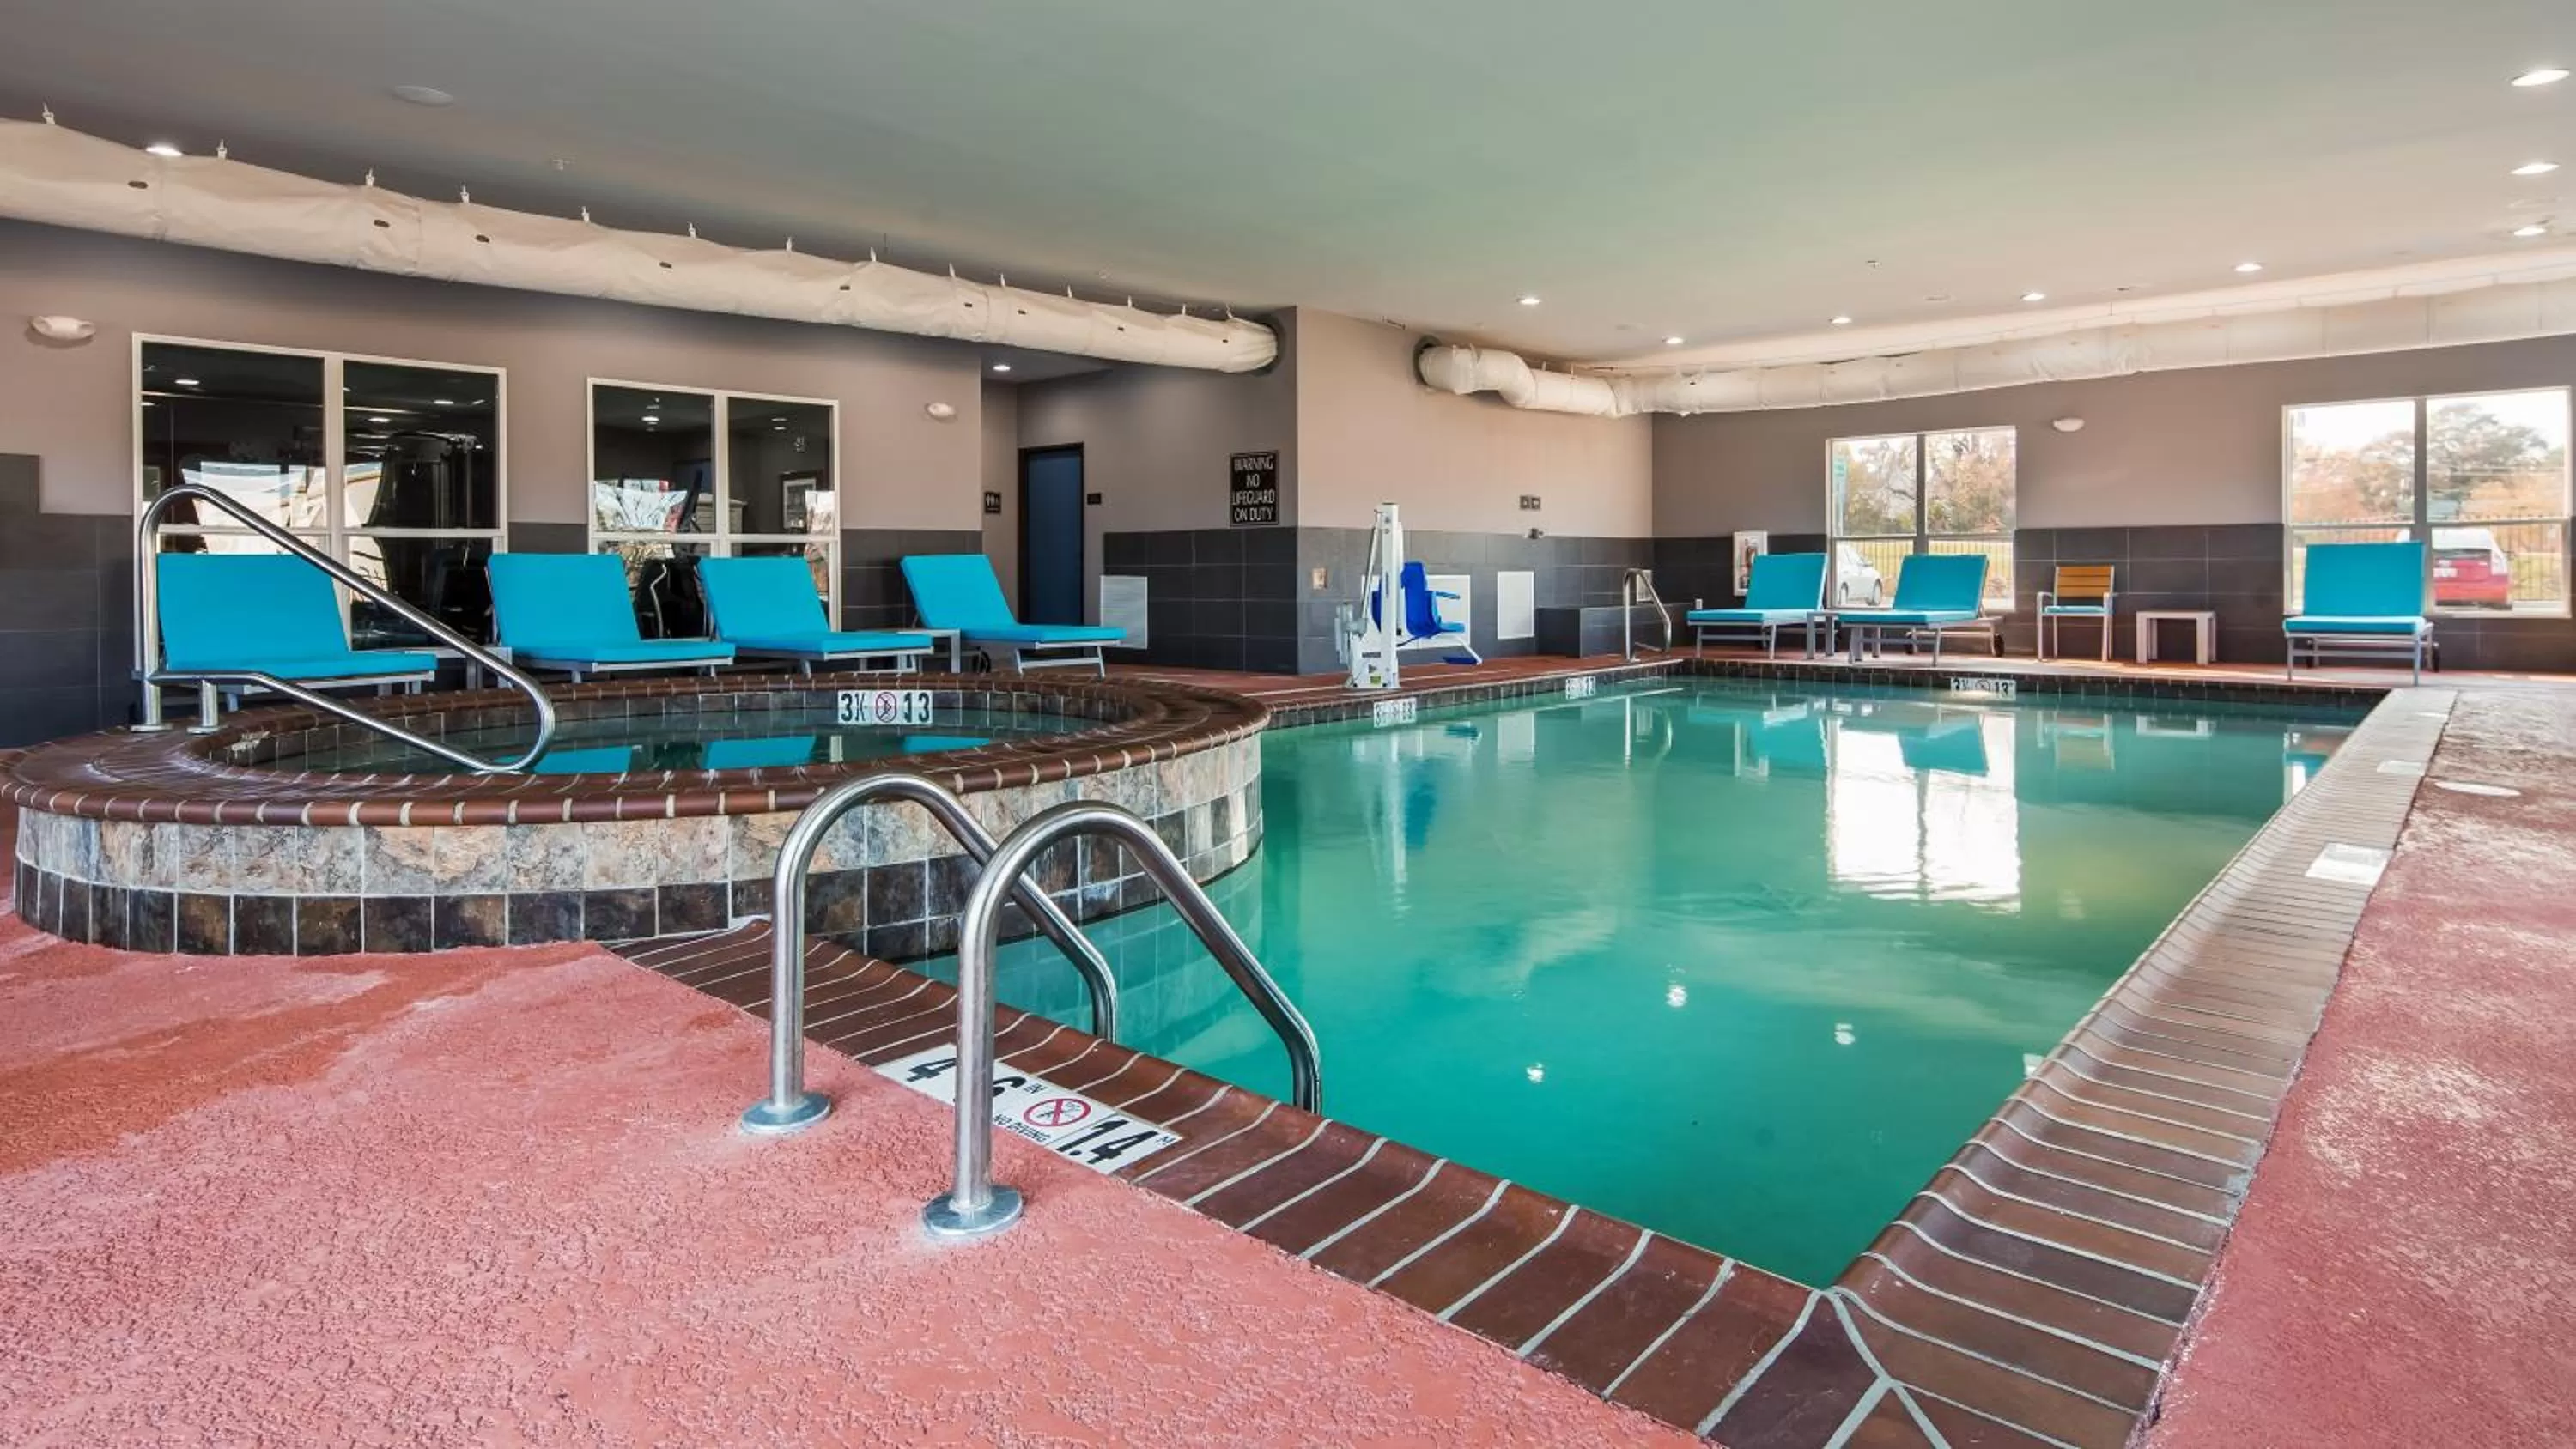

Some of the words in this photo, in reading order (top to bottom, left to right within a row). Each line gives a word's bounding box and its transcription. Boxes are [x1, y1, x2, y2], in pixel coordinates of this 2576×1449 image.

[1234, 455, 1274, 471] WARNING
[1246, 473, 1260, 488] NO
[1231, 488, 1275, 506] LIFEGUARD
[1234, 507, 1248, 522] ON
[1249, 506, 1273, 521] DUTY
[993, 1114, 1012, 1125] NO
[1006, 1122, 1051, 1143] DIVING
